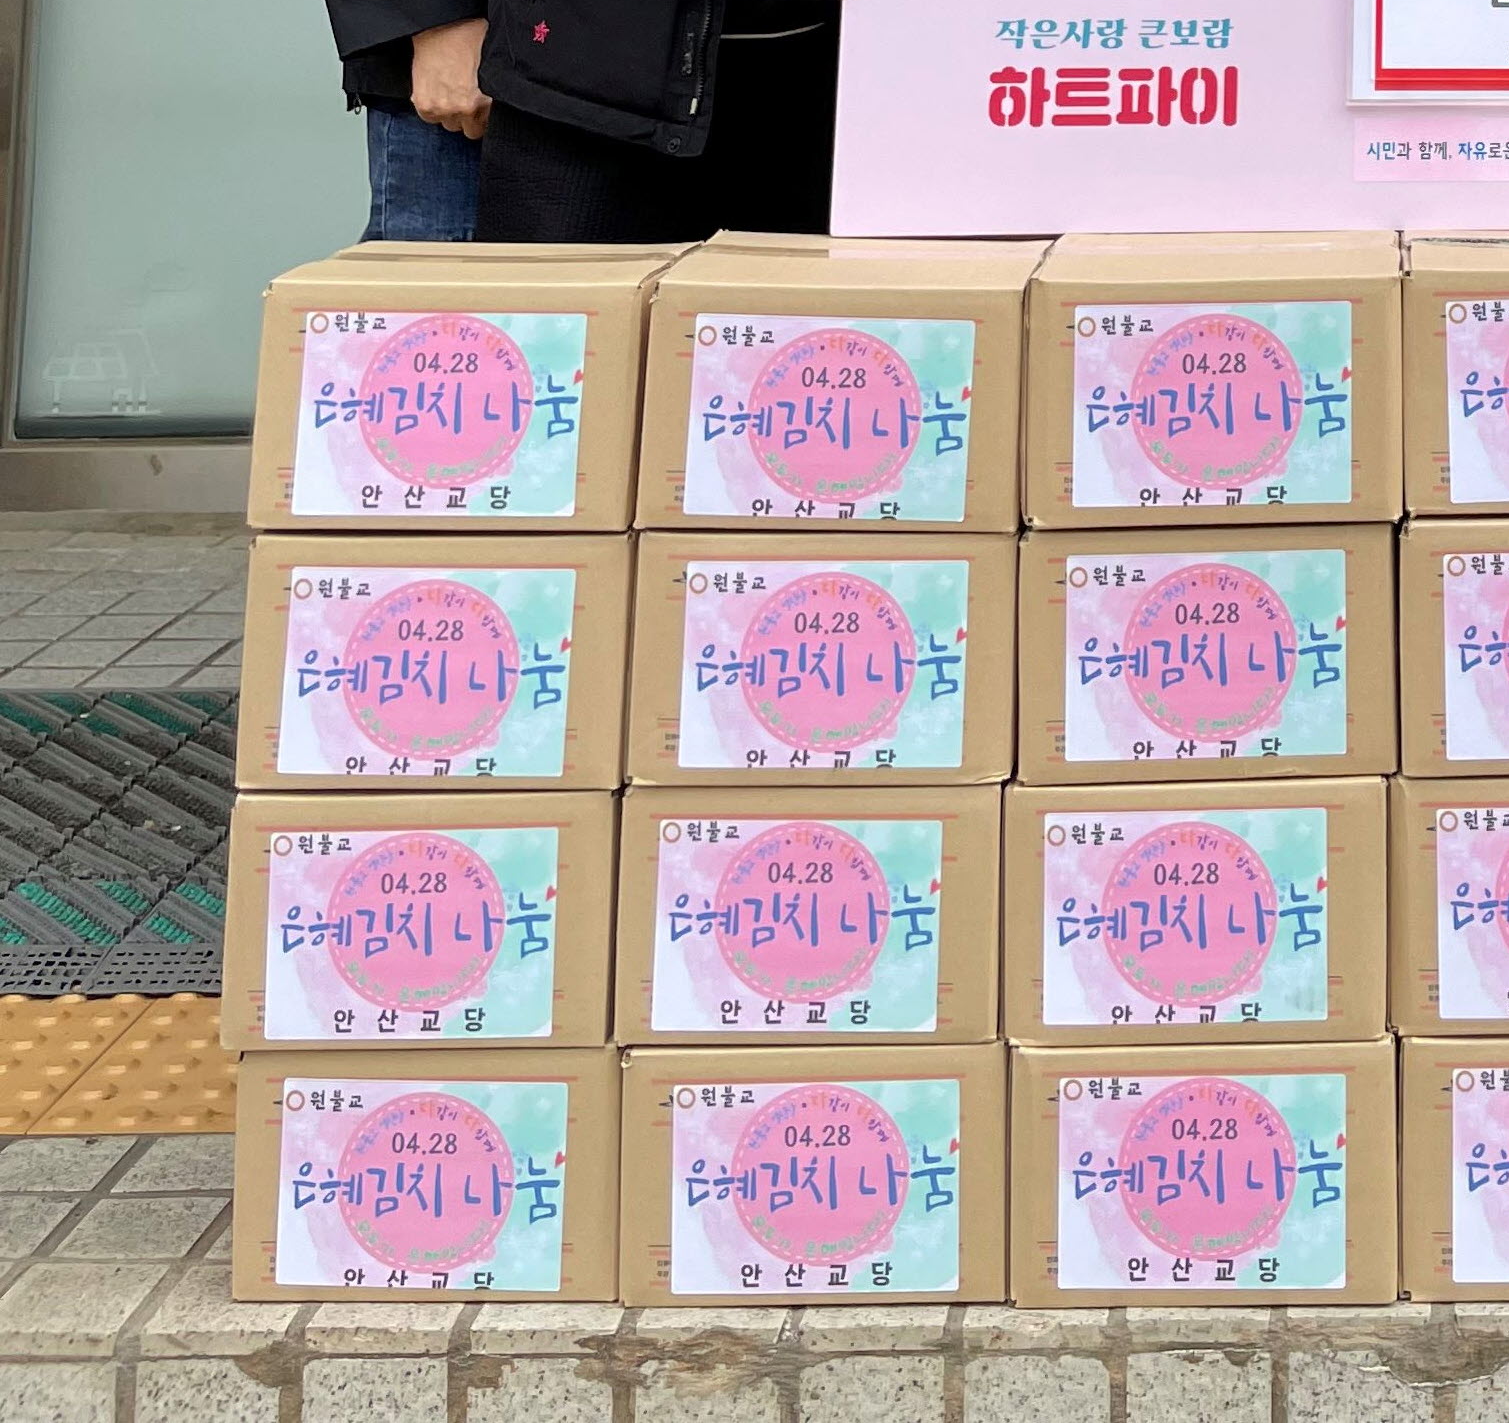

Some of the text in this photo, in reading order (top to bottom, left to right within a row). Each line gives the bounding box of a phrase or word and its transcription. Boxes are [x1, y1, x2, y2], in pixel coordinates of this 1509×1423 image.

[995, 18, 1234, 50] 작은사랑 큰보람
[988, 66, 1238, 126] 하트파이
[1367, 142, 1412, 160] 시민과
[412, 353, 479, 374] 04.28
[801, 368, 867, 389] 04.28
[1181, 353, 1247, 375] 04.28
[314, 375, 580, 441] 은혜김치 나눔
[703, 392, 968, 458] 은혜김치 나눔
[1086, 373, 1349, 439] 은혜김치 나눔
[397, 620, 464, 642] 04.28
[793, 612, 860, 634] 04.28
[1174, 602, 1240, 626] 04.28
[297, 643, 567, 711] 은혜김치 나눔
[695, 634, 963, 702] 은혜김치 나눔
[1079, 623, 1343, 690] 은혜김치 나눔
[298, 833, 352, 856] 원불교
[686, 820, 740, 844] 원불교
[1070, 822, 1125, 847] 원불교
[281, 893, 552, 960] 은혜김치 나눔
[669, 885, 937, 953] 은혜김치 나눔
[1056, 884, 1324, 953] 은혜김치 나눔
[310, 1089, 364, 1113] 원불교
[700, 1085, 755, 1109] 원불교
[292, 1158, 562, 1225] 은혜김치 나눔
[686, 1146, 957, 1214] 은혜김치 나눔
[1073, 1141, 1344, 1209] 은혜김치 나눔
